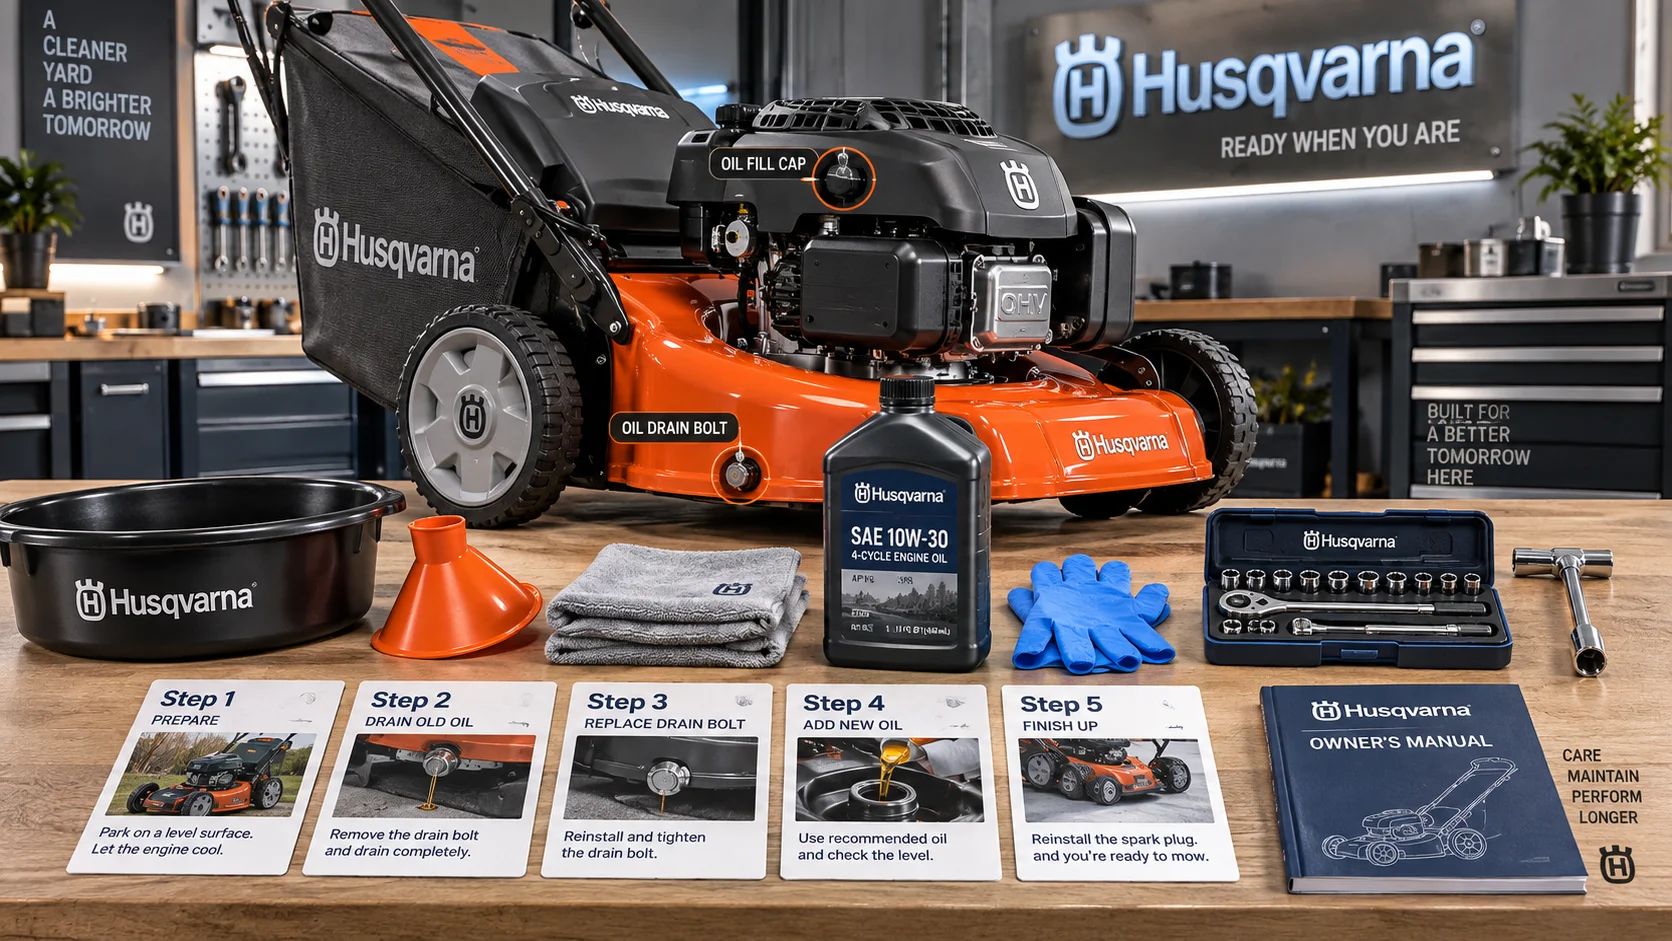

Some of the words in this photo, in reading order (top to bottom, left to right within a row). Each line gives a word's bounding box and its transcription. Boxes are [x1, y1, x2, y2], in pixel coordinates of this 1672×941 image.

[43, 10, 56, 29] A
[43, 35, 128, 63] CLEANER
[43, 62, 92, 84] YARD
[1133, 31, 1474, 118] Husqvarna
[43, 88, 56, 107] A
[62, 89, 152, 115] BRIGHTER
[594, 99, 669, 119] Husqvarna
[43, 114, 152, 141] TOMORROW
[1222, 133, 1287, 158] READY
[1293, 128, 1356, 152] WHEN
[1363, 124, 1407, 148] YOU
[1414, 119, 1460, 144] ARE
[343, 222, 475, 283] Husqvarna
[1001, 292, 1048, 315] OHV
[1428, 402, 1474, 419] BUILT
[1479, 404, 1509, 419] FOR
[1427, 426, 1438, 442] A
[1445, 426, 1510, 442] BETTER
[1093, 433, 1169, 457] Husqvarna
[1427, 448, 1530, 465] TOMORROW
[1427, 469, 1474, 486] HERE
[872, 487, 945, 504] Husqvarna
[852, 526, 882, 546] SAE
[888, 528, 948, 548] 10W-30
[1322, 534, 1397, 550] Husqvarna
[852, 550, 891, 561] 4-CYCLE
[894, 552, 929, 562] ENGINE
[932, 553, 947, 563] OIL
[110, 587, 254, 620] Husqvarna
[161, 690, 217, 710] Step
[225, 691, 235, 706] 1
[371, 692, 428, 712] Step
[434, 692, 451, 708] 2
[588, 693, 645, 713] Step
[652, 694, 667, 710] 3
[804, 695, 861, 715] Step
[868, 695, 884, 711] 4
[1021, 696, 1079, 716] Step
[1087, 696, 1102, 712] 5
[151, 715, 220, 725] PREPARE
[1344, 705, 1471, 719] Husqvarna
[366, 717, 412, 726] DRAIN
[416, 717, 446, 727] OLD
[450, 717, 473, 727] OIL
[585, 719, 652, 728] REPLACE
[657, 719, 703, 729] DRAIN
[708, 719, 746, 729] BOLT
[804, 720, 835, 729] ADD
[840, 720, 874, 730] NEW
[879, 720, 902, 730] OIL
[1024, 720, 1073, 732] FINISH
[1077, 720, 1099, 732] UP
[1310, 737, 1401, 749] OWNER'S
[1406, 735, 1493, 747] MANUAL
[1563, 749, 1601, 762] CARE
[1568, 770, 1639, 782] MAINTAIN
[1572, 790, 1642, 803] PERFORM
[1580, 811, 1638, 823] LONGER
[99, 827, 130, 837] Park
[154, 830, 162, 838] a
[166, 827, 197, 838] level
[200, 828, 252, 838] surface.
[330, 829, 384, 840] Remove
[389, 829, 410, 840] the
[414, 830, 448, 840] drain
[453, 830, 479, 840] bolt
[564, 831, 623, 842] Reinstall
[628, 832, 653, 842] and
[658, 832, 705, 845] tighten
[799, 833, 824, 843] Use
[829, 833, 927, 844] recommended
[932, 834, 946, 844] oil
[1032, 834, 1091, 844] Reinstall
[1095, 834, 1117, 844] the
[1122, 834, 1160, 846] spark
[1164, 834, 1197, 847] plug.
[92, 844, 115, 854] Let
[118, 843, 139, 854] the
[143, 844, 189, 857] engine
[192, 844, 222, 854] cool.
[325, 845, 352, 856] and
[355, 845, 389, 856] drain
[393, 846, 470, 859] completely.
[562, 847, 584, 858] the
[588, 848, 622, 858] drain
[627, 848, 657, 858] bolt.
[798, 849, 823, 860] and
[828, 850, 868, 860] check
[872, 850, 894, 860] the
[899, 850, 933, 860] level.
[1034, 850, 1059, 861] and
[1063, 850, 1106, 863] you're
[1111, 851, 1149, 864] ready
[1153, 852, 1167, 861] to
[1172, 853, 1208, 861] mow.
